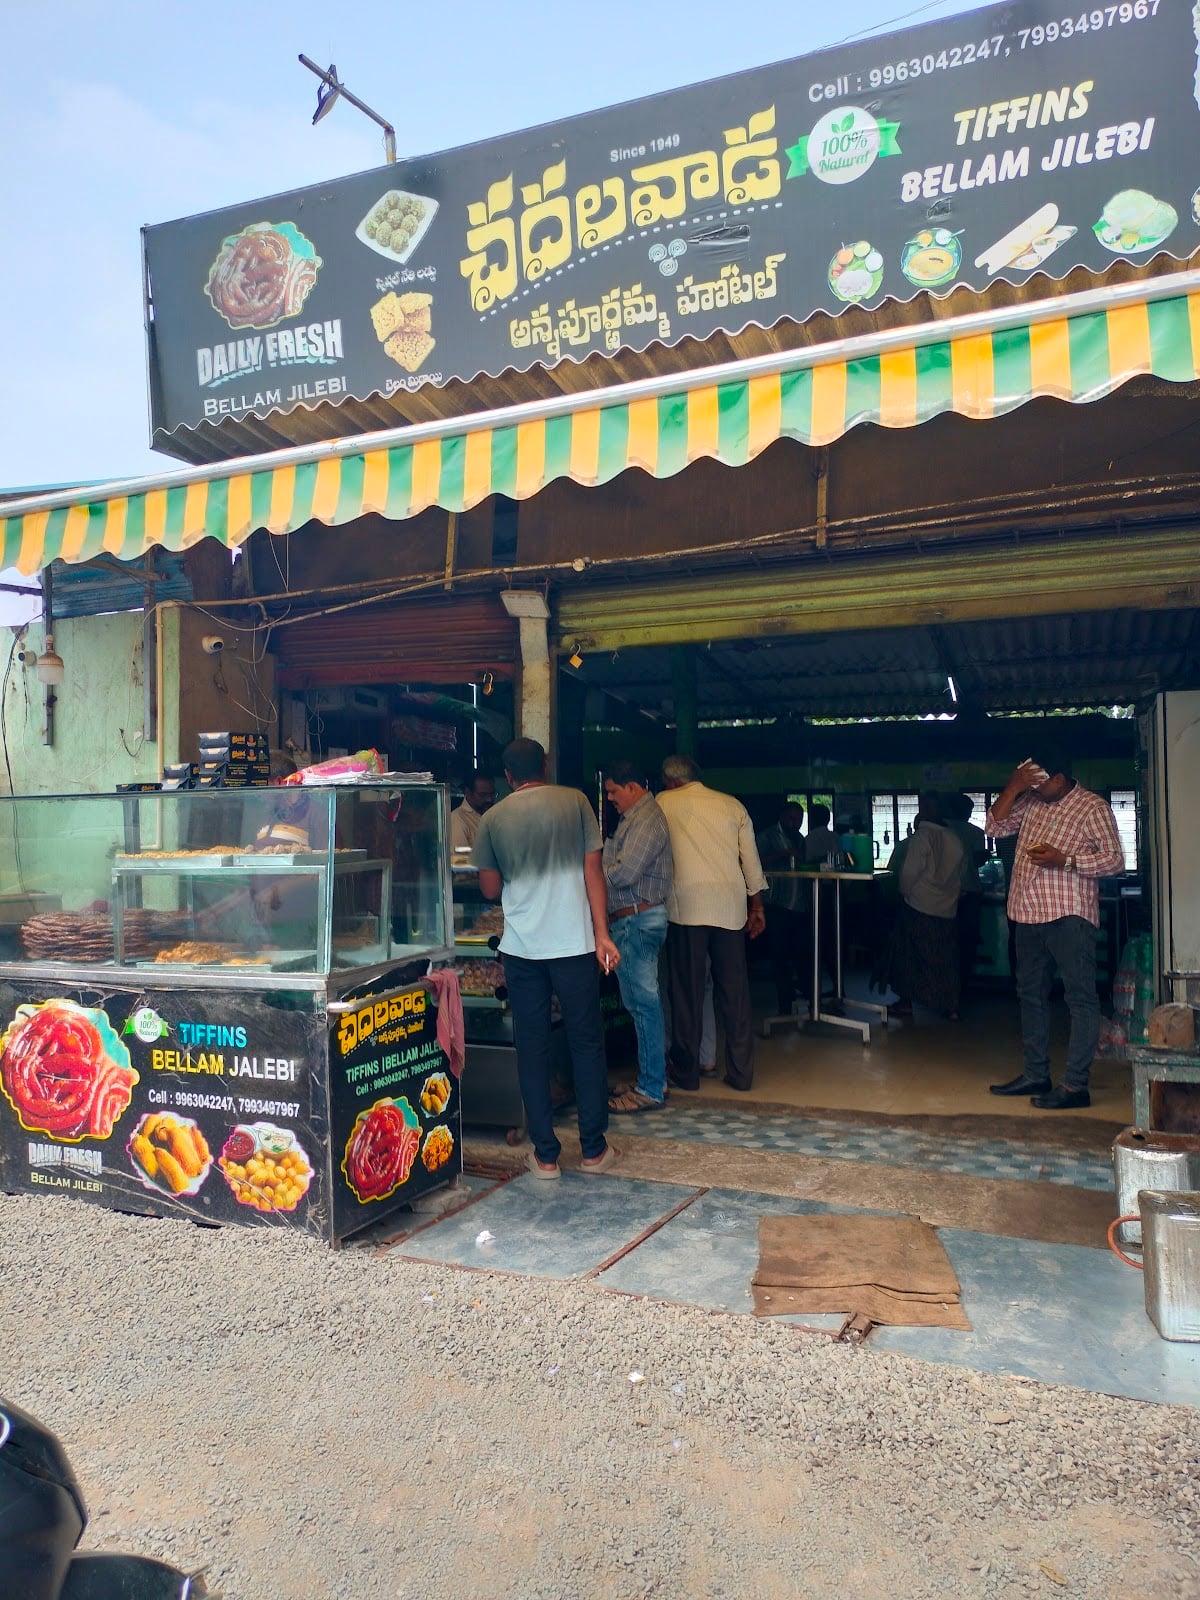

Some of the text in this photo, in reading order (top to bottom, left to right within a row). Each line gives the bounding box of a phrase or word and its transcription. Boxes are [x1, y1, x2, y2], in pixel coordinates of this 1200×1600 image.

[808, 77, 849, 102] Cell
[869, 35, 1011, 88] 9963042247,
[1017, 0, 1160, 50] 7993497967
[953, 80, 1093, 145] TIFFINS
[610, 134, 680, 162] Since 1949
[820, 130, 868, 157] 100%
[818, 152, 870, 174] Natural
[901, 118, 1155, 202] BELLAM JILEBI
[197, 319, 344, 388] DAILY FRESH
[204, 376, 347, 416] BELLAM JILEBI
[179, 1022, 248, 1048] TIFFINS
[152, 1049, 295, 1081] BELLAM JALEBI
[345, 1060, 379, 1084] TIFFINS
[148, 1089, 167, 1105] Cell
[238, 1097, 300, 1118] 7993497967
[31, 1172, 103, 1193] BELLAM JILEBI
